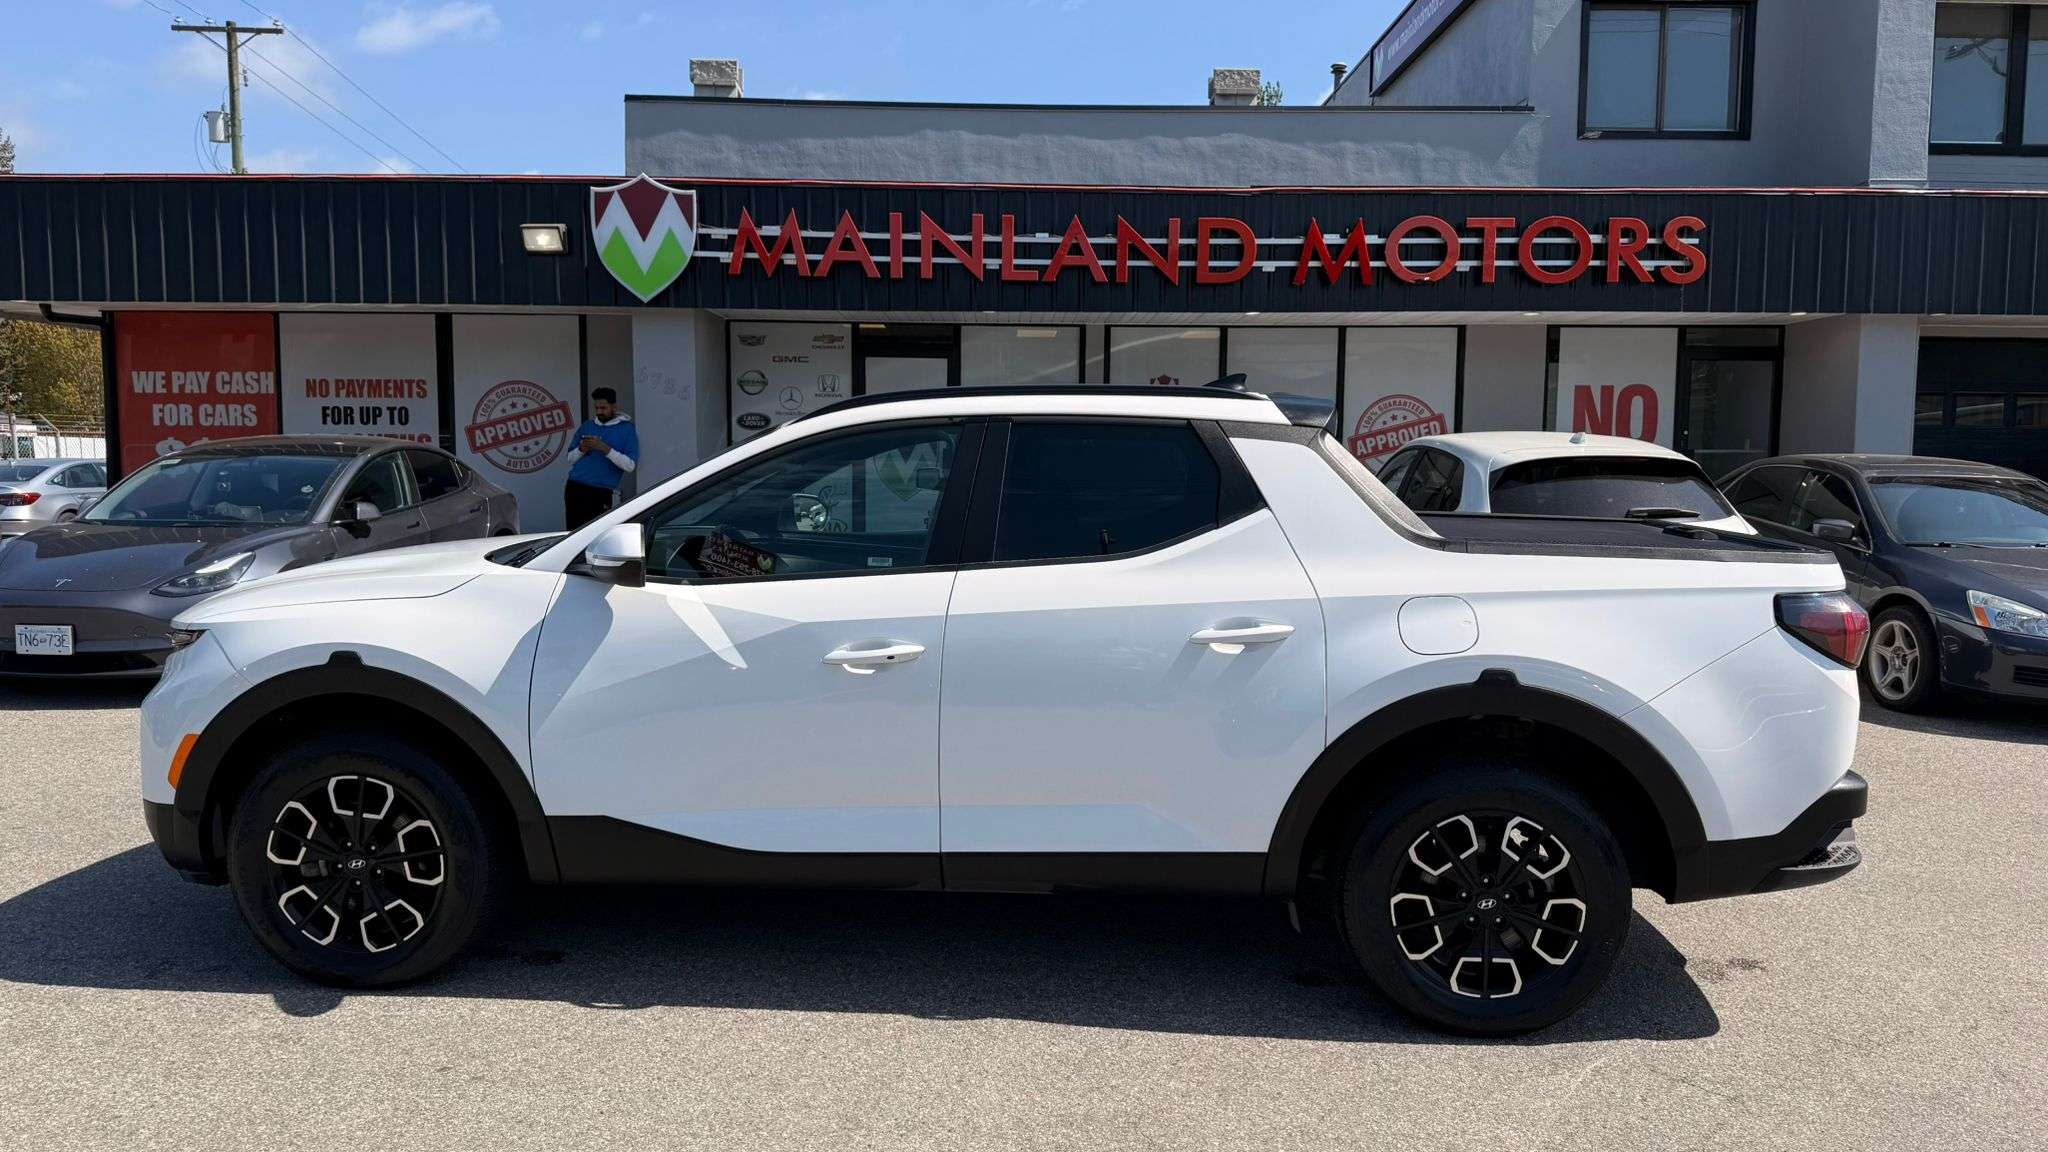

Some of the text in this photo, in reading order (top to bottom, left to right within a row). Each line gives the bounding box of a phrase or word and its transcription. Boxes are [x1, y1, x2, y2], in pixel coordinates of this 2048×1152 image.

[728, 207, 1707, 286] MAINLAND MOTORS
[132, 371, 274, 394] WE PAY CASH
[305, 379, 428, 399] NO PAYMENTS
[495, 386, 546, 403] GUARANTEED
[153, 404, 257, 427] FOR CARS
[322, 406, 409, 425] FOR UP TO
[1378, 400, 1425, 415] GUARANTEED
[1573, 384, 1658, 443] NO
[475, 409, 567, 447] APPROVED
[1357, 421, 1440, 455] APPROVED
[506, 449, 552, 468] AUTO LOAN
